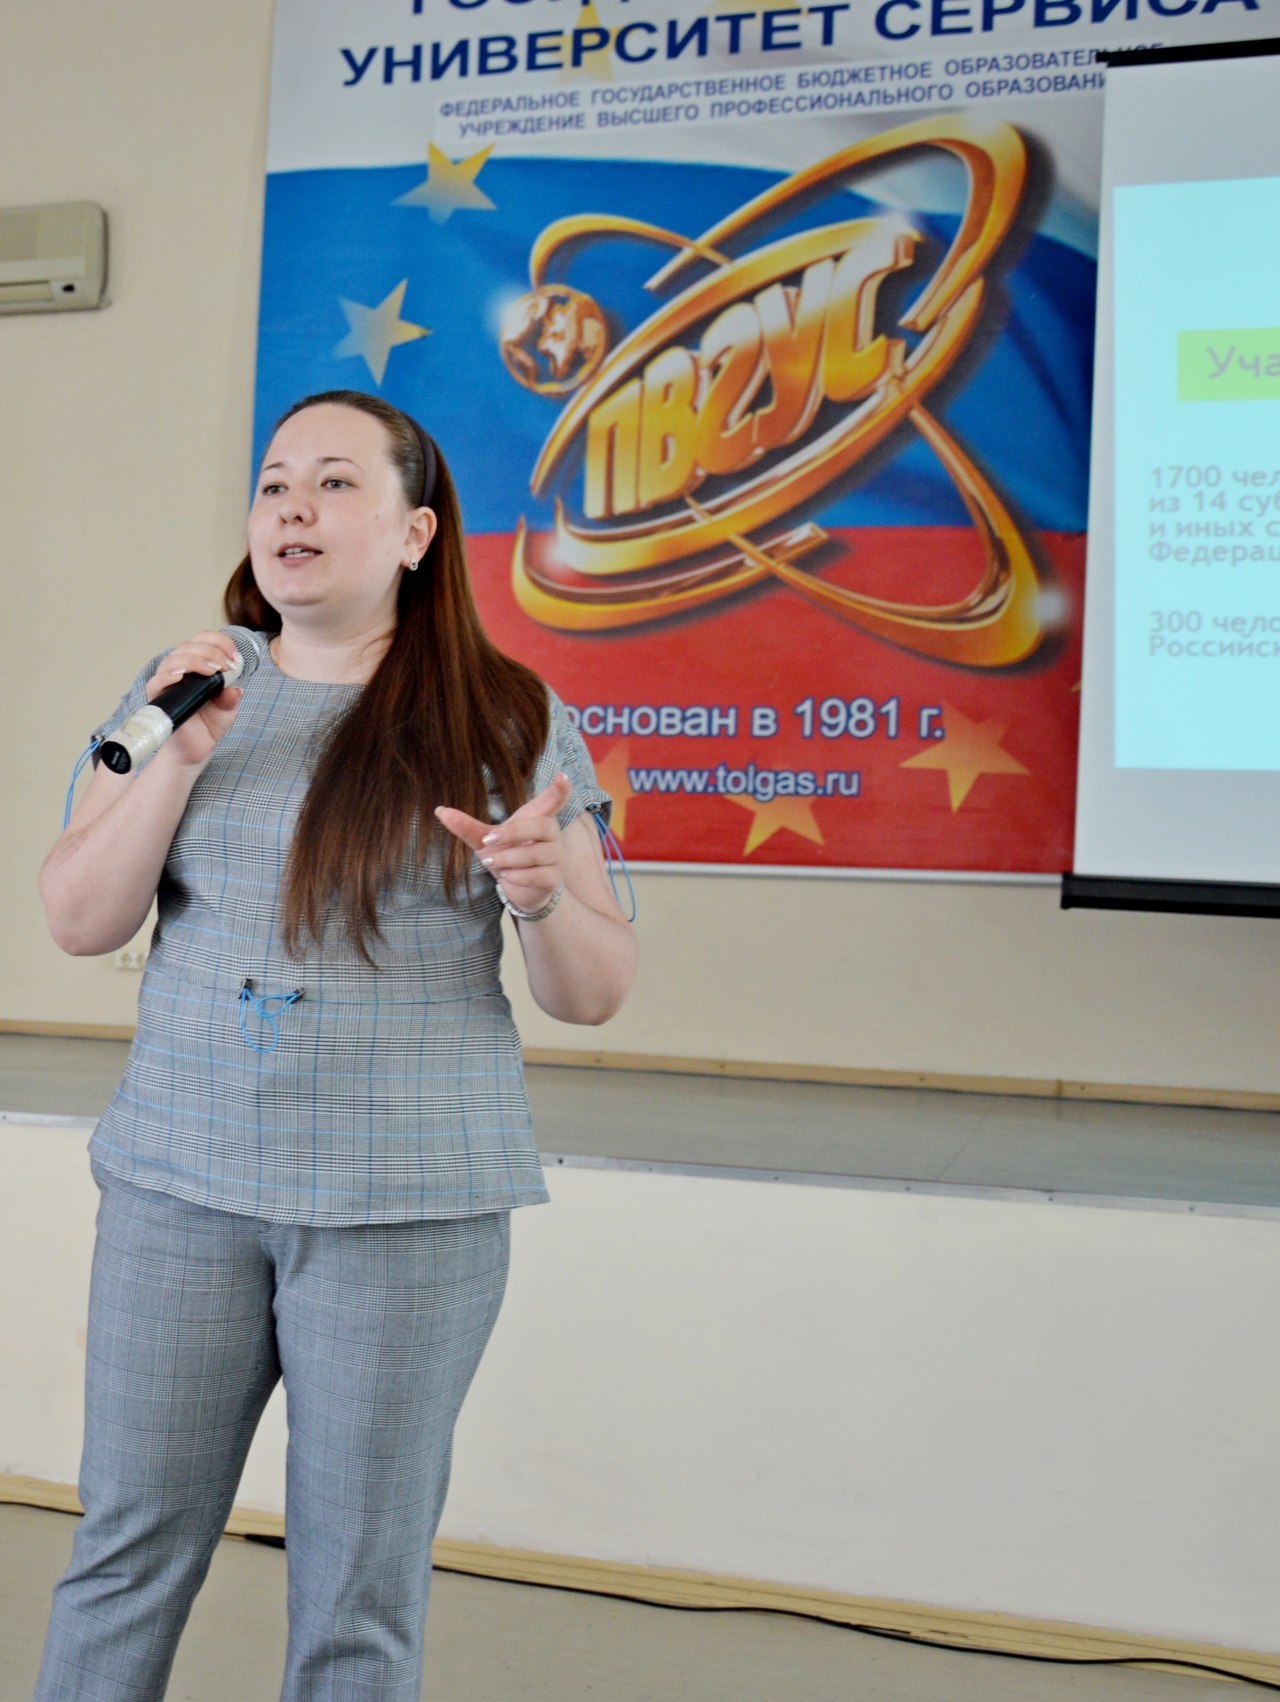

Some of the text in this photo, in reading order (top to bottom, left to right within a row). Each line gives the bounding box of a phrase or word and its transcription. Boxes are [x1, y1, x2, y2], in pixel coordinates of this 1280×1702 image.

[340, 4, 850, 87] УНИВЕРСИТЕТ
[439, 42, 1164, 118] ФЕДЕРАЛЬНОЕ ГОСУДАРСТВЕННОЕ БЮДЖЕТНОЕ ОБРАЗОВАТЕЛ
[458, 112, 587, 139] УЧРЕЖДЕНИЕ
[596, 103, 701, 128] ВЫСШЕГО
[709, 83, 955, 119] ПРОФЕССИОНАЛЬНОГО
[1151, 464, 1222, 488] 1700
[1148, 496, 1181, 513] из
[1193, 489, 1228, 512] 14
[1148, 522, 1166, 537] и
[1175, 521, 1254, 537] иных
[1150, 610, 1202, 633] 300
[751, 706, 778, 737] в
[794, 697, 901, 738] 1981
[919, 706, 946, 738] г.
[628, 763, 860, 801] www.tolgas.ru
